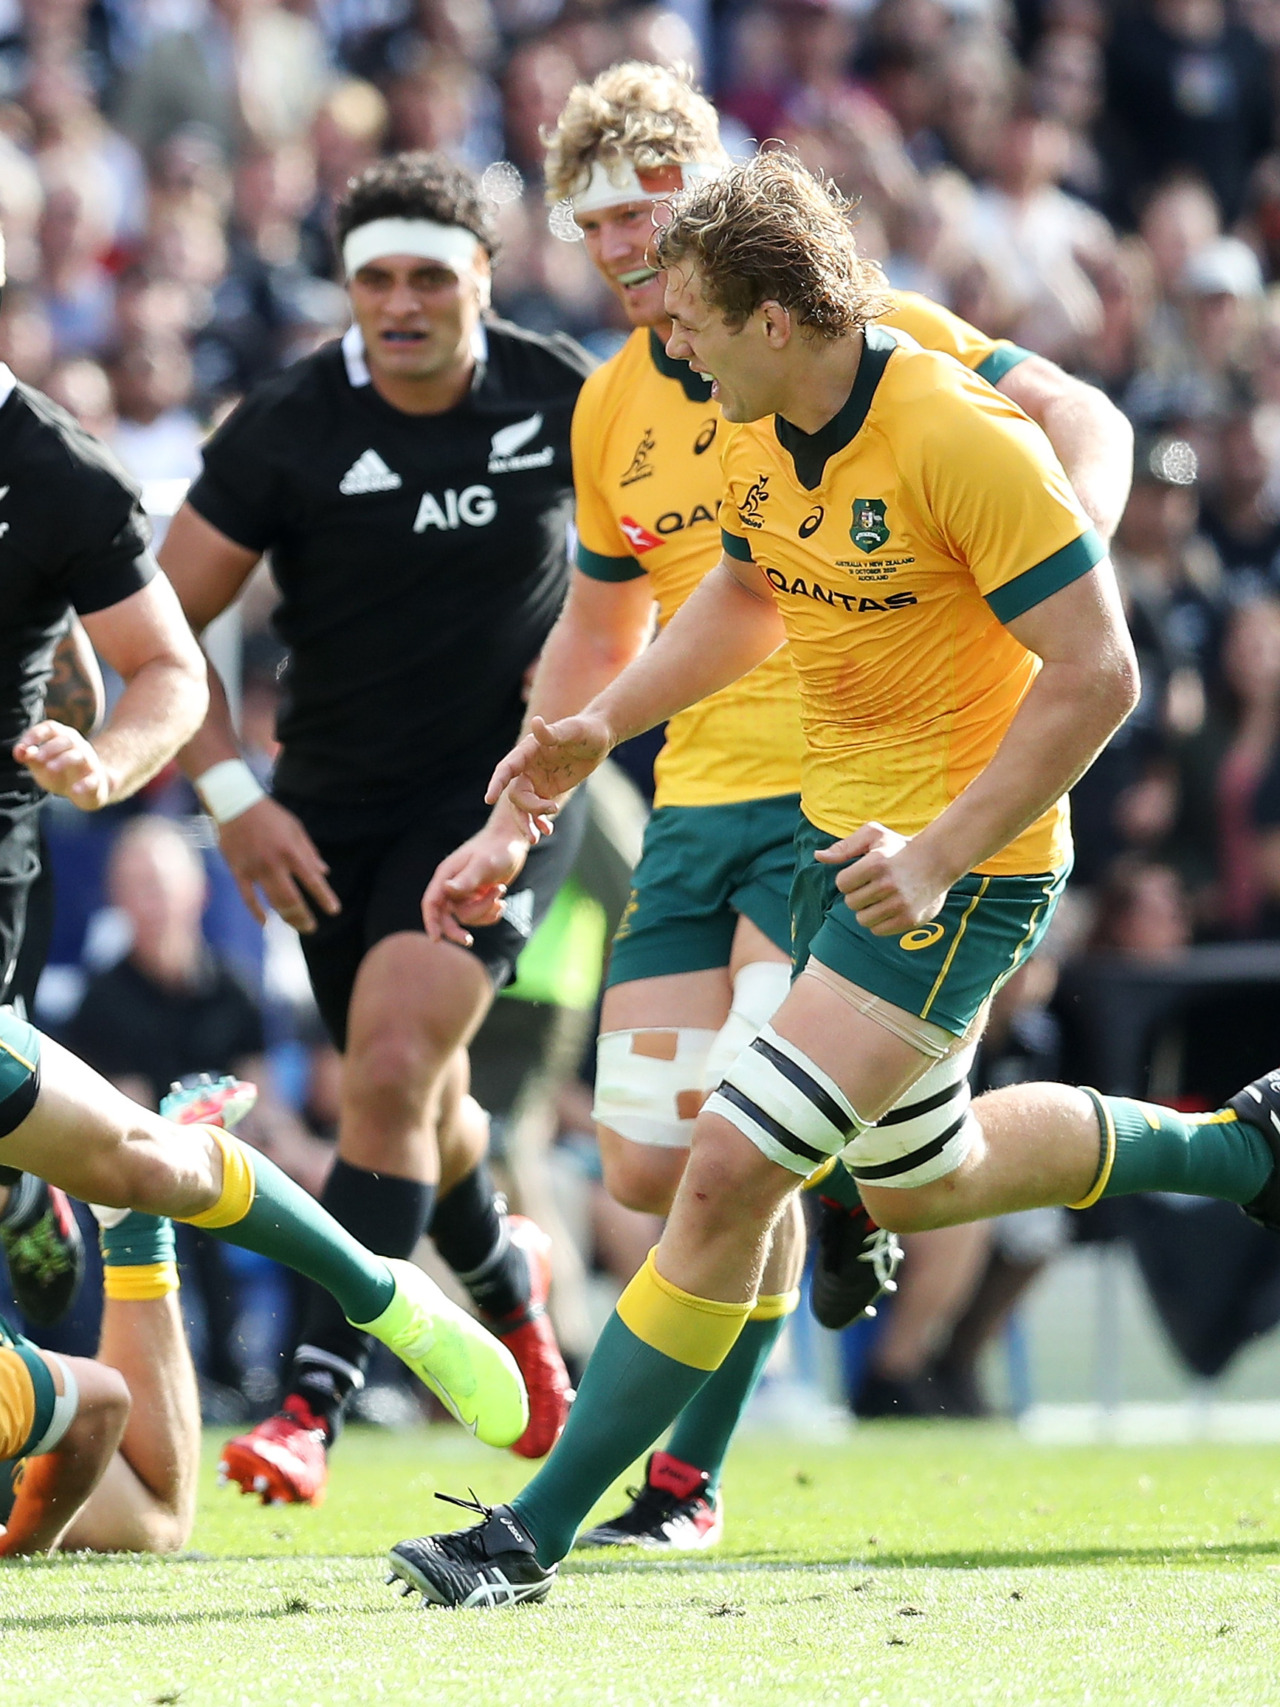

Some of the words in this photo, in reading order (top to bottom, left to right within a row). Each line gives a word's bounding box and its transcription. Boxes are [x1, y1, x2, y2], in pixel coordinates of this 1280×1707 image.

[412, 484, 498, 534] AIG
[885, 557, 915, 566] ZEALAND
[766, 568, 918, 612] QANTAS
